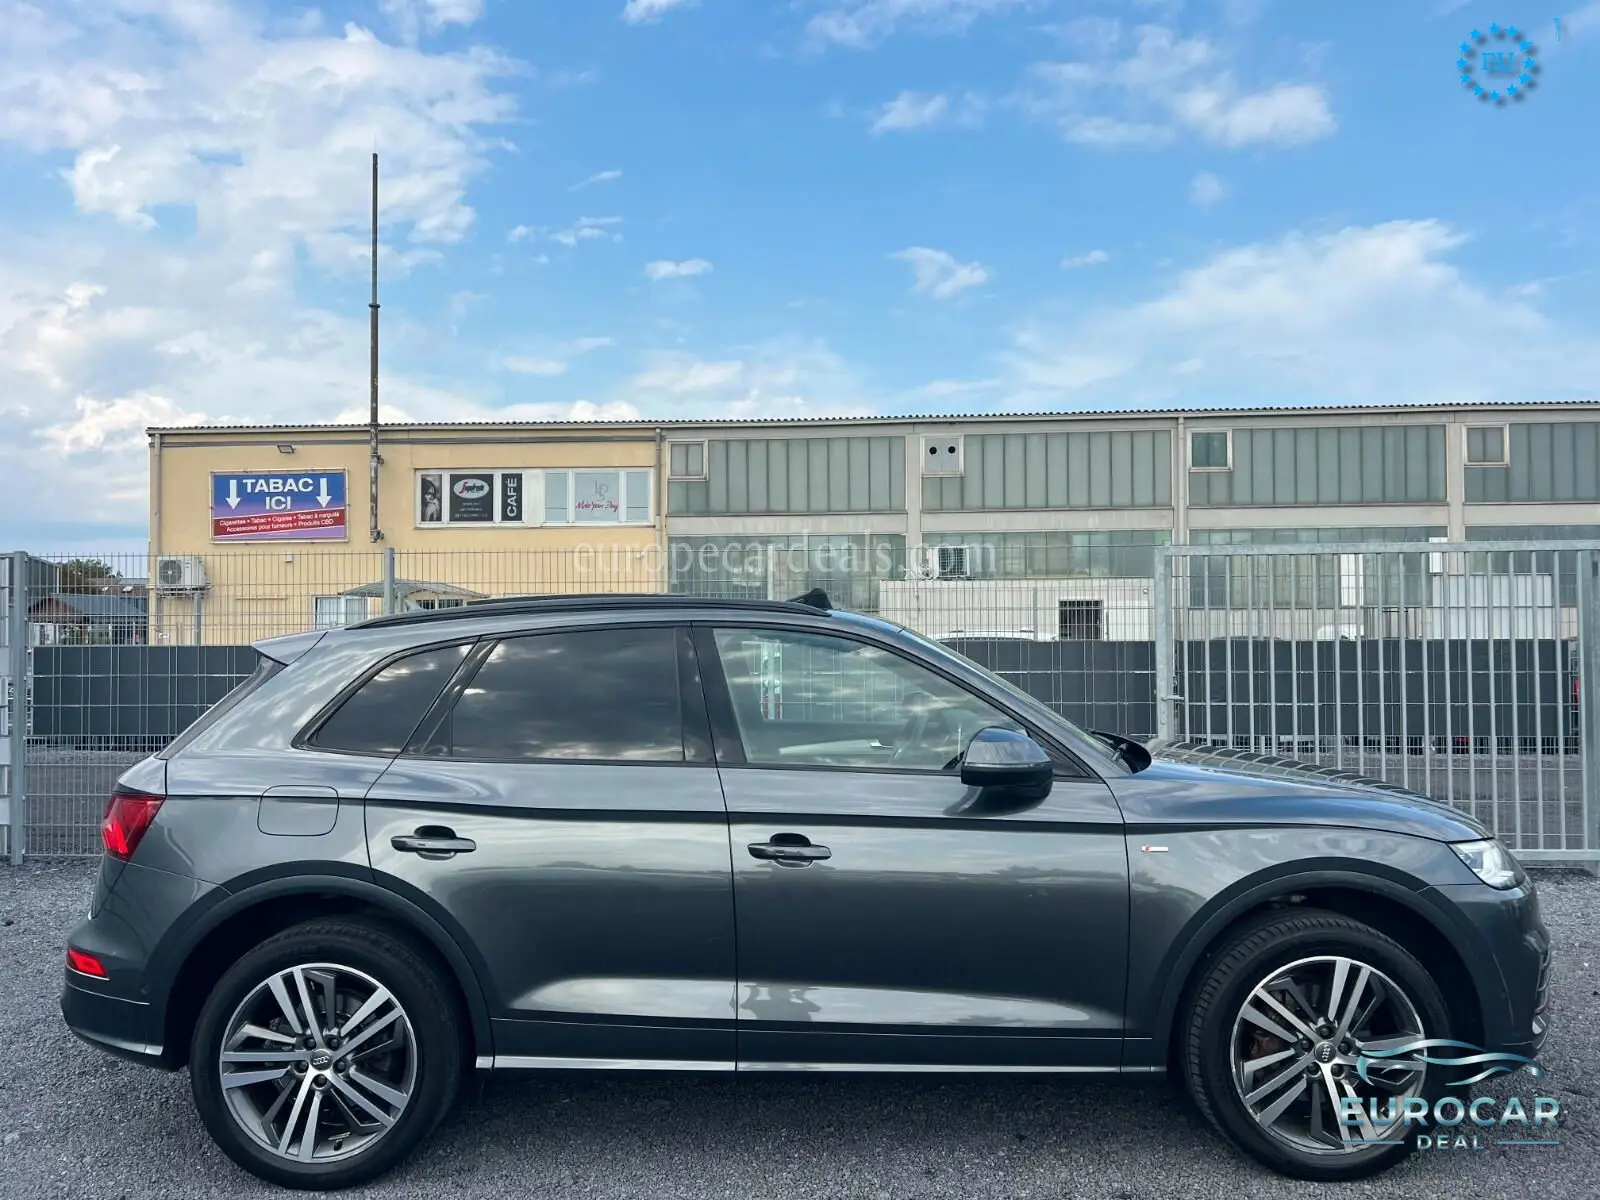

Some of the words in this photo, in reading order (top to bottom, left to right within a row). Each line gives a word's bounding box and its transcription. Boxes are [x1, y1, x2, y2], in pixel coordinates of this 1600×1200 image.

[242, 477, 313, 493] TABAC
[265, 495, 291, 510] ICI
[505, 477, 517, 517] CAFÉ
[219, 519, 246, 527] Cigarettes
[272, 515, 293, 523] Cigares
[258, 524, 271, 532] pour
[271, 522, 293, 530] fumeurs
[298, 519, 320, 527] Produits
